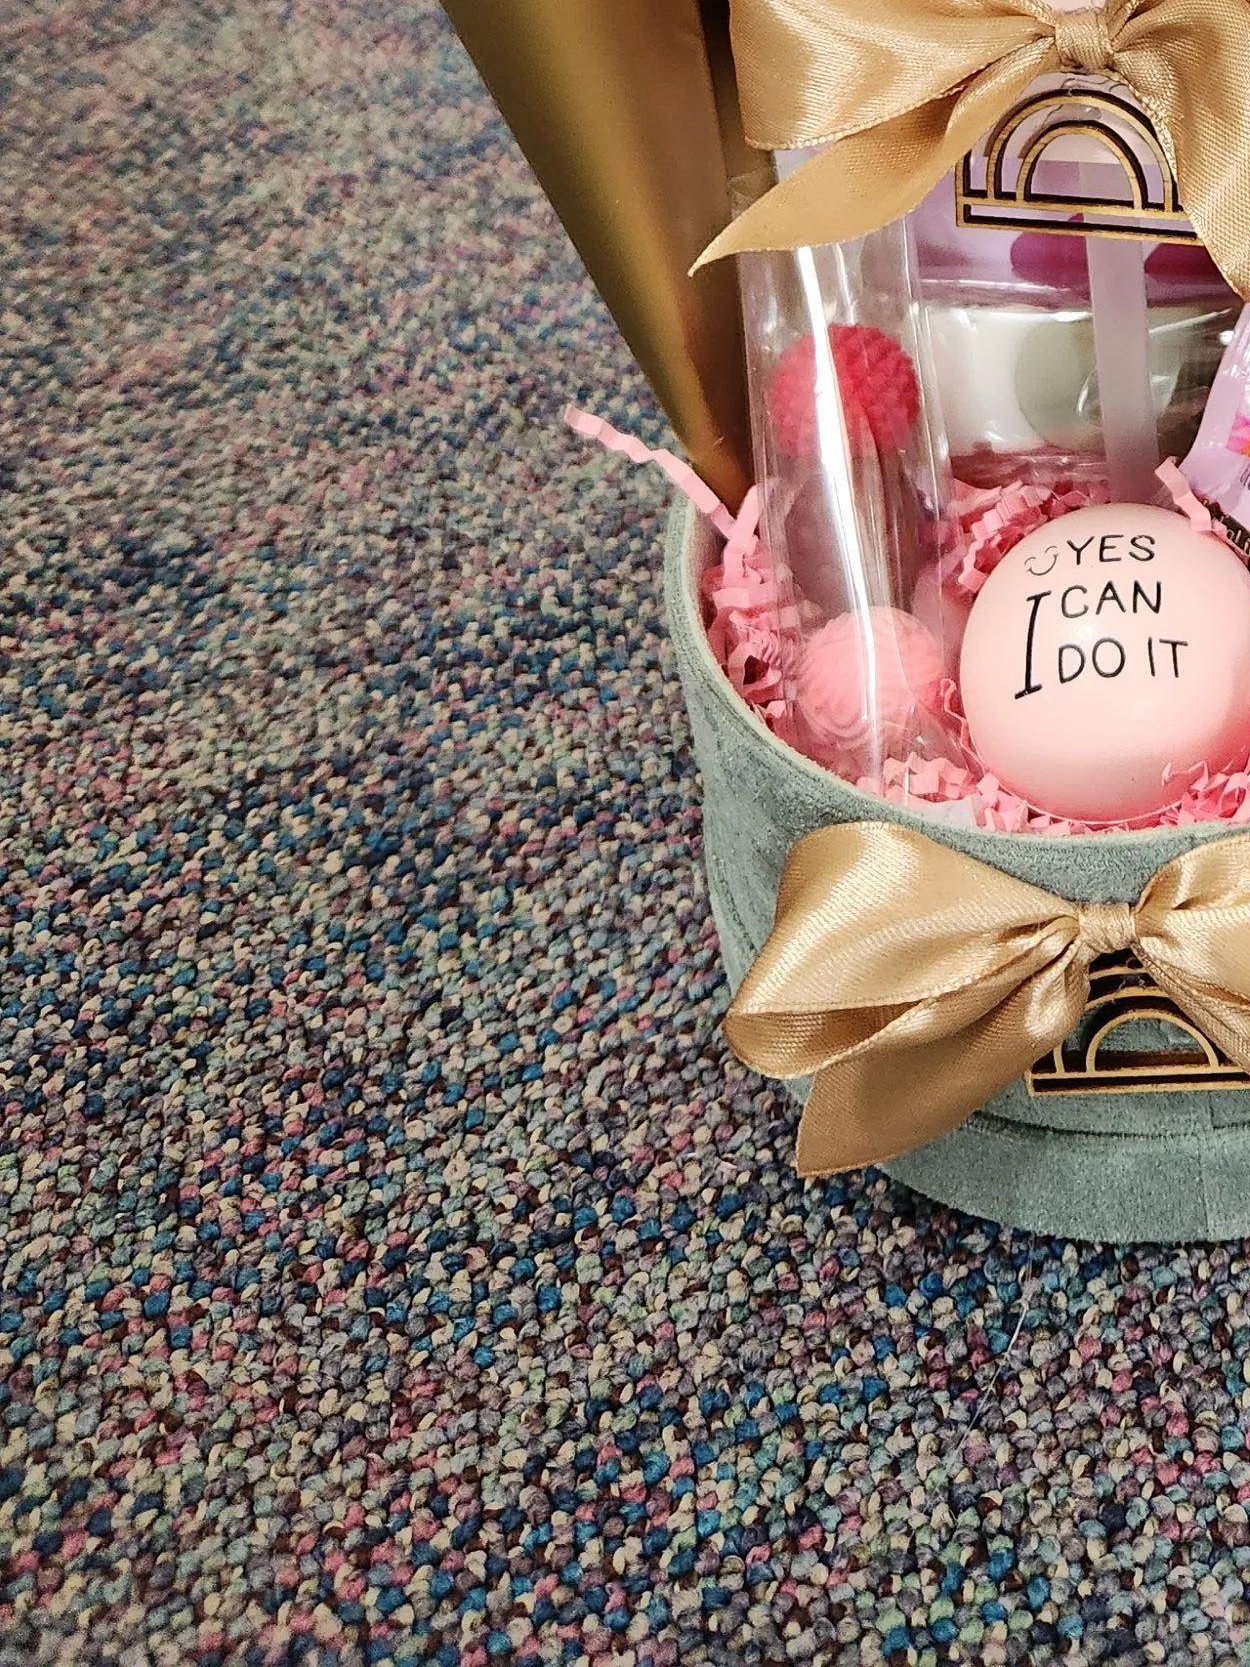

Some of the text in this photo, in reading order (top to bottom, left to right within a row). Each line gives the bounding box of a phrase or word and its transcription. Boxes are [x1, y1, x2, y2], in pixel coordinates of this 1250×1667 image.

[1067, 534, 1156, 566] YES
[1014, 580, 1162, 700] I CAN
[1058, 636, 1189, 684] DO IT
